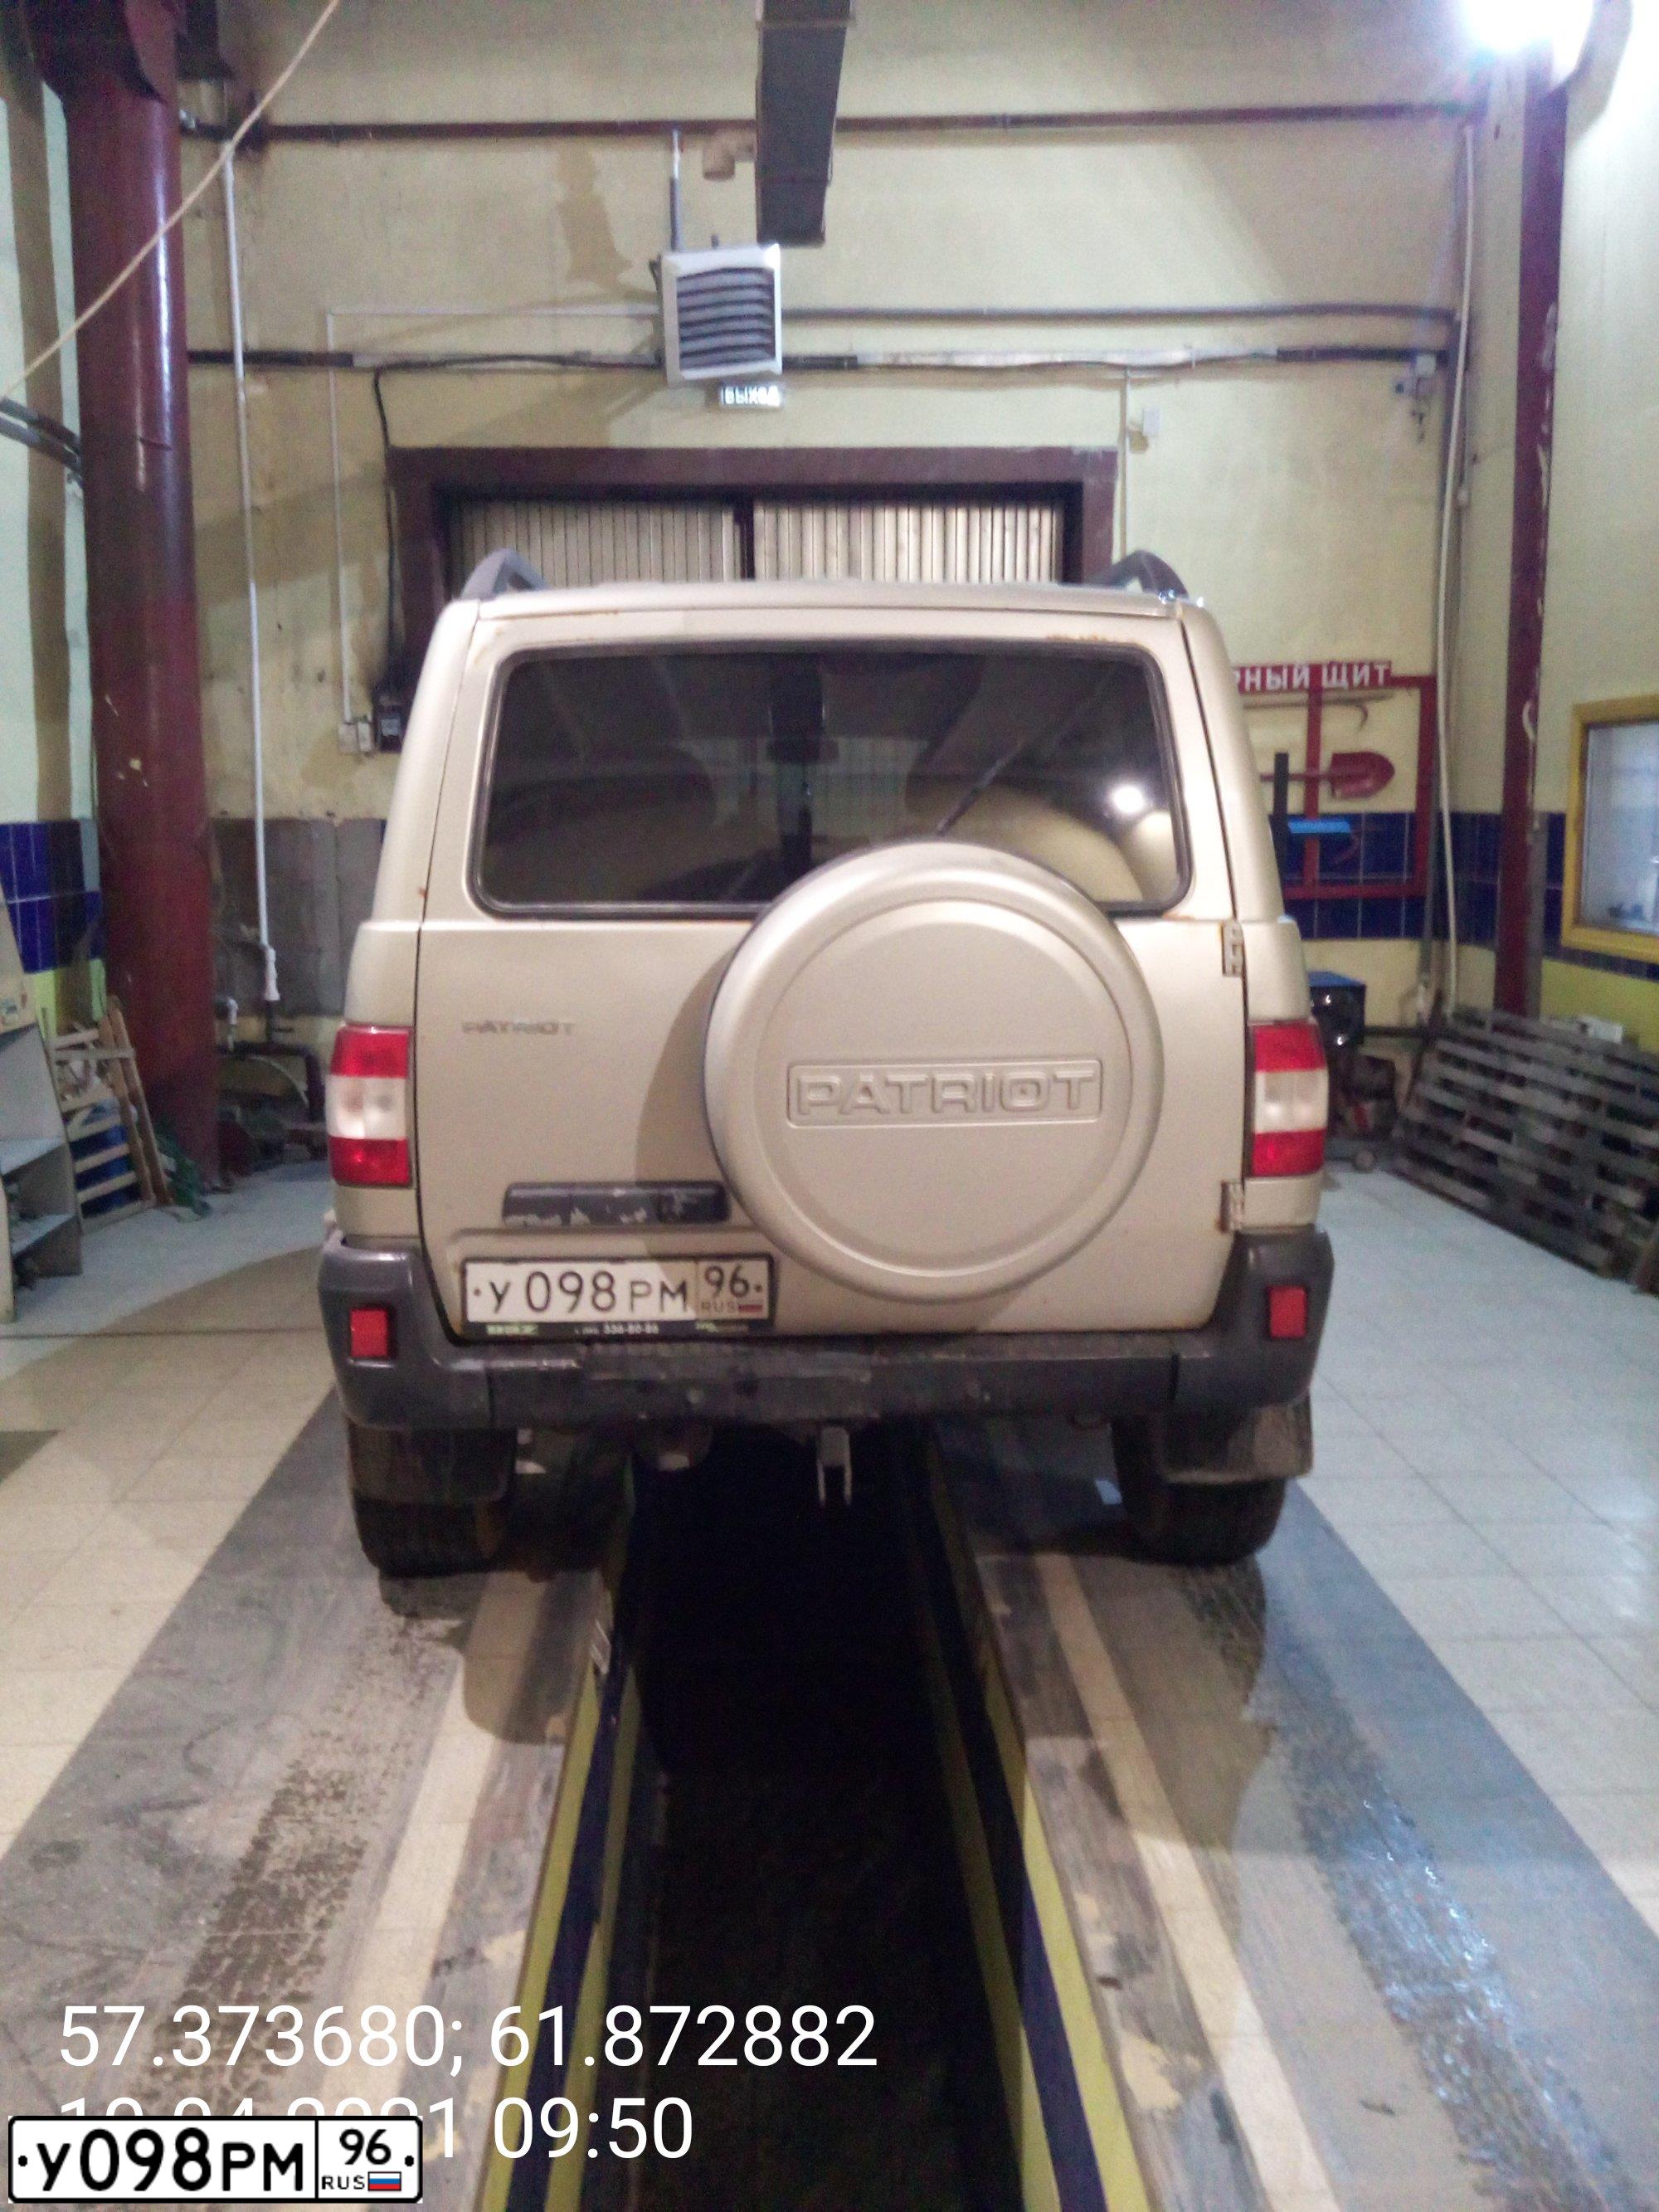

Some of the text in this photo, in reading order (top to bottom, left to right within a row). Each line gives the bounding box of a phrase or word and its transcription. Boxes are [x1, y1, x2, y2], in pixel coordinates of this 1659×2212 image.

[1322, 663, 1389, 689] ЩИТ
[793, 1068, 1096, 1115] PATRIOT
[704, 1265, 749, 1297] 96
[701, 1301, 735, 1313] RUS
